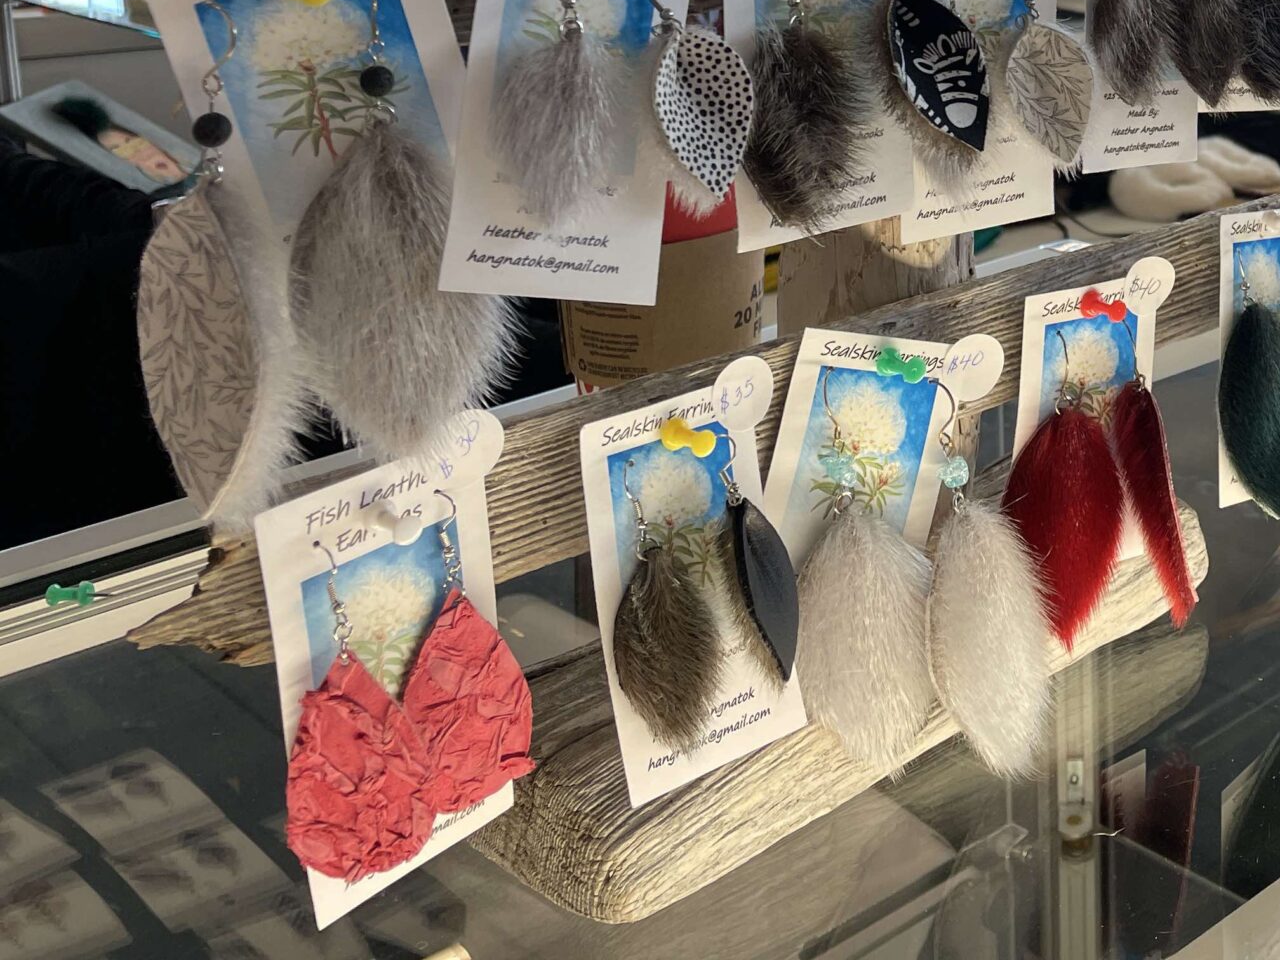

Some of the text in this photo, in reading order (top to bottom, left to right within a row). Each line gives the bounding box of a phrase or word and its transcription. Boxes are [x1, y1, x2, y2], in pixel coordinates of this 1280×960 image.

[1127, 108, 1147, 118] Made
[1111, 122, 1175, 136] Heather Angnatok
[1104, 139, 1180, 156] hangnatok@gmail.com
[916, 190, 1025, 221] hangnak@gmail.com
[482, 224, 541, 242] Heather
[466, 248, 620, 276] hangnatok@gmail.com
[1129, 275, 1161, 299] $40
[734, 306, 752, 329] 20
[1042, 297, 1081, 317] Sealsk
[821, 340, 882, 362] Sealskin
[946, 350, 984, 376] $40
[601, 397, 716, 446] Sealskin Earrin
[305, 499, 350, 535] Fish
[710, 686, 755, 718] ngnatok
[647, 706, 771, 772] hangk@gmail.com
